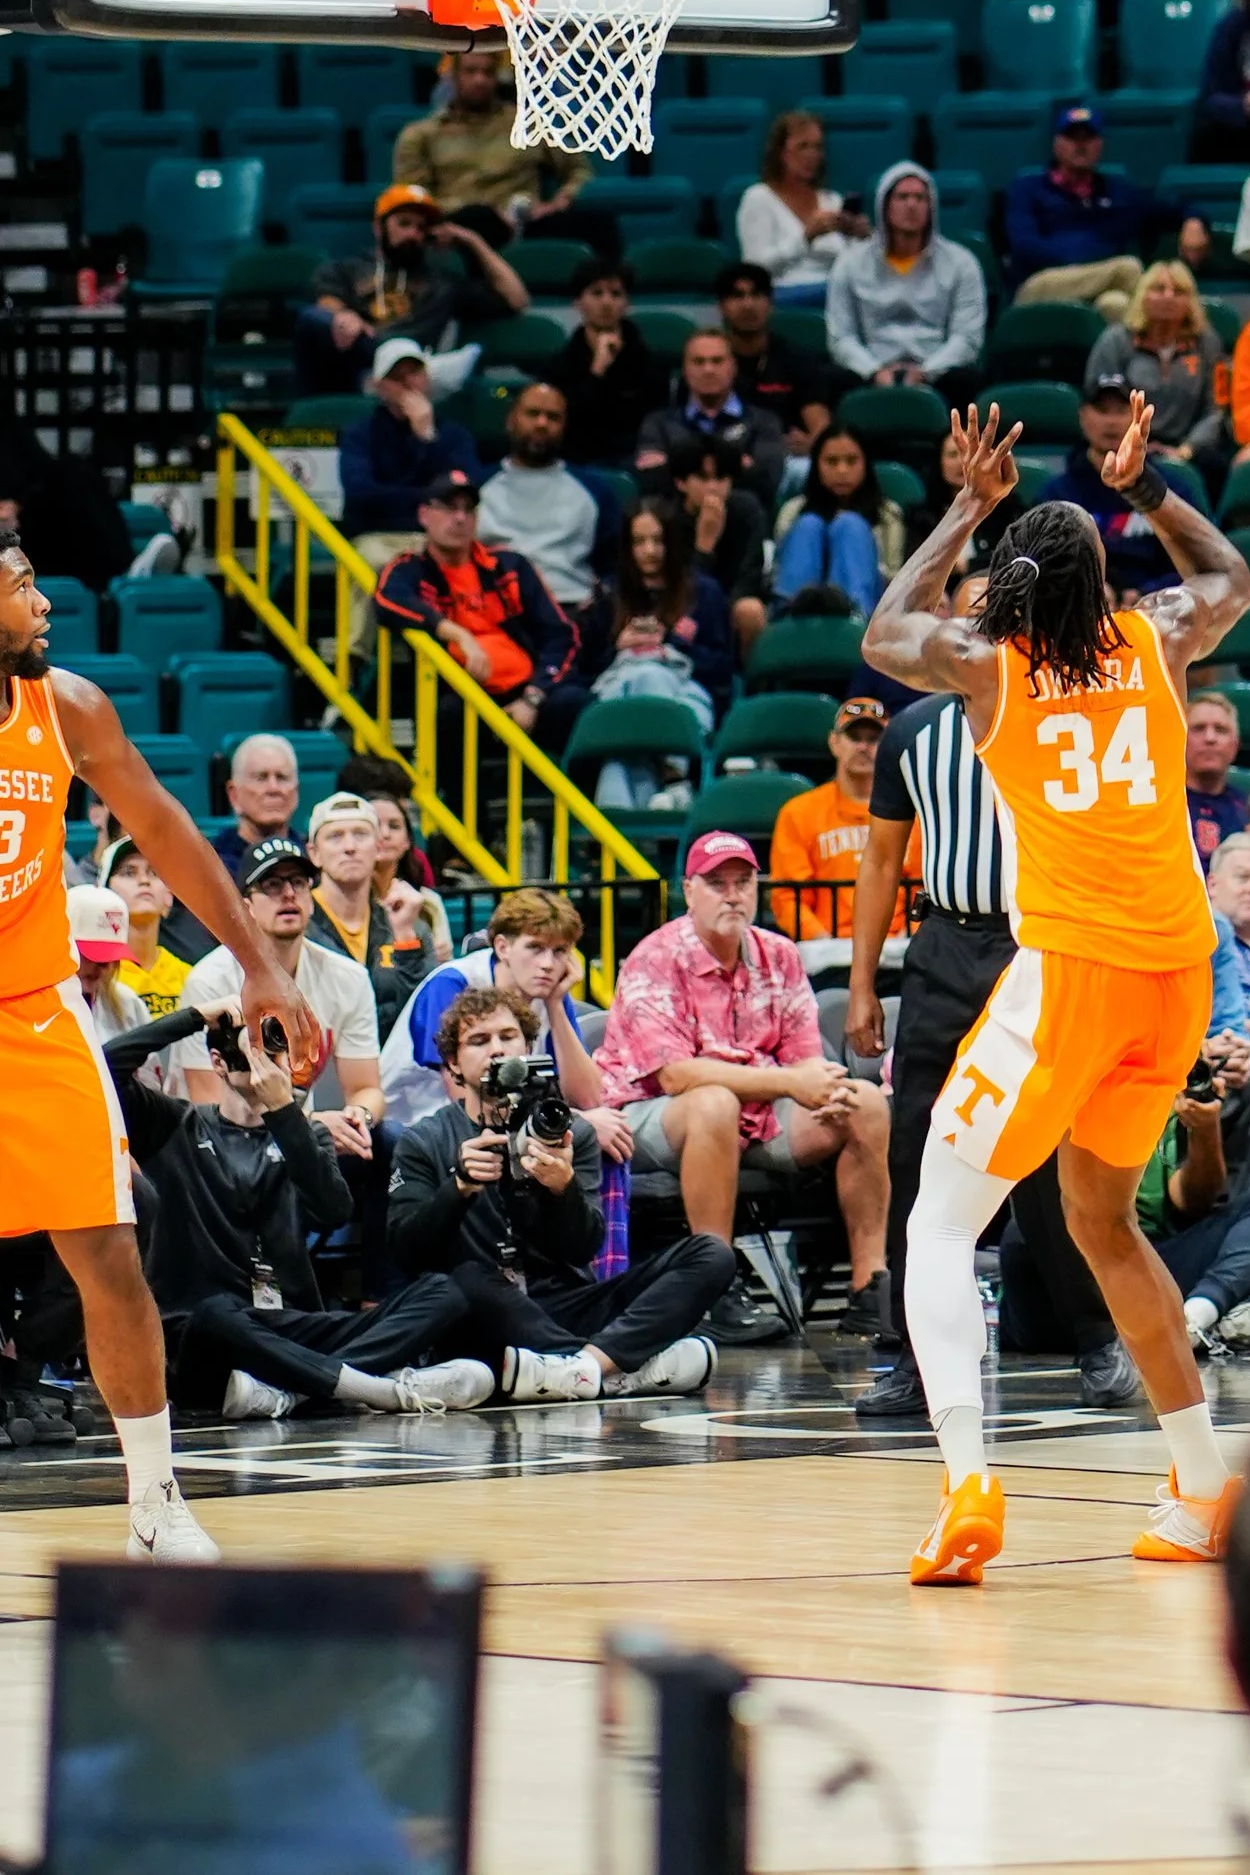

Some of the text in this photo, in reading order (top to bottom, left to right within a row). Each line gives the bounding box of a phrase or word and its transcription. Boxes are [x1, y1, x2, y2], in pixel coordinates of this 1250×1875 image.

[1037, 706, 1157, 812] 34
[0, 809, 26, 865] 3
[954, 1063, 1006, 1128] T
